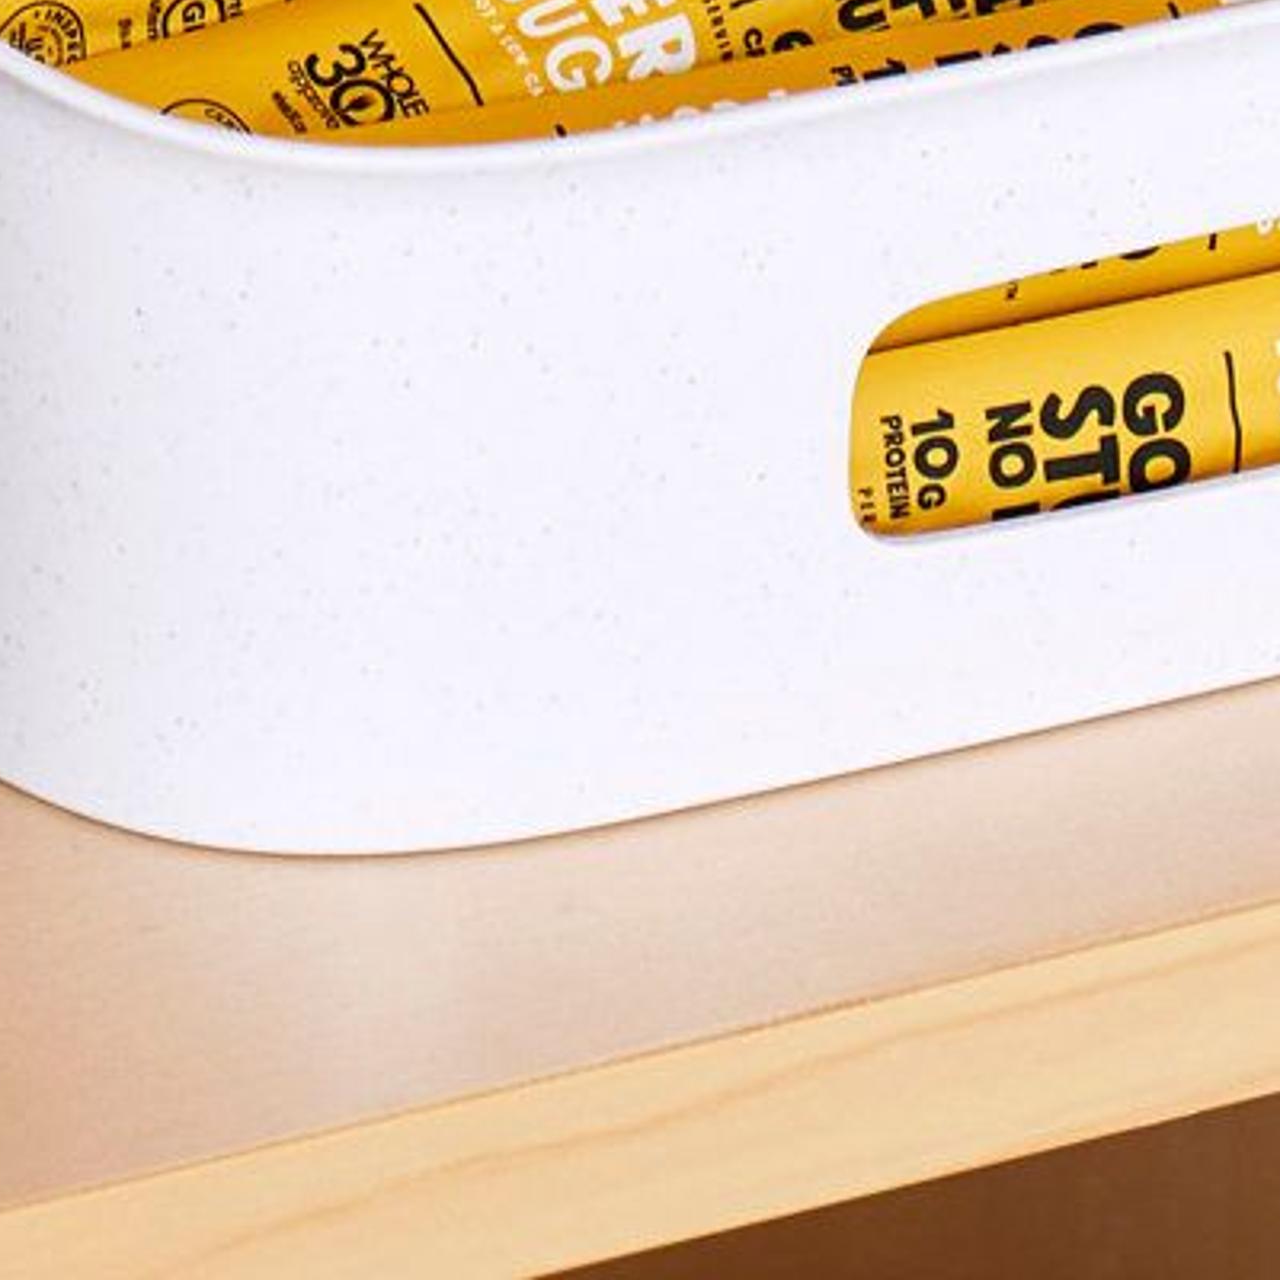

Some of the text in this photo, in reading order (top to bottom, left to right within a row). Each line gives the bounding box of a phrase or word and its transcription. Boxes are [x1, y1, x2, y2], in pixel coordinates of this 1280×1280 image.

[359, 26, 431, 120] WHOLE
[879, 414, 911, 521] PROTEIN
[909, 407, 960, 511] 10G
[984, 400, 1037, 490] NO
